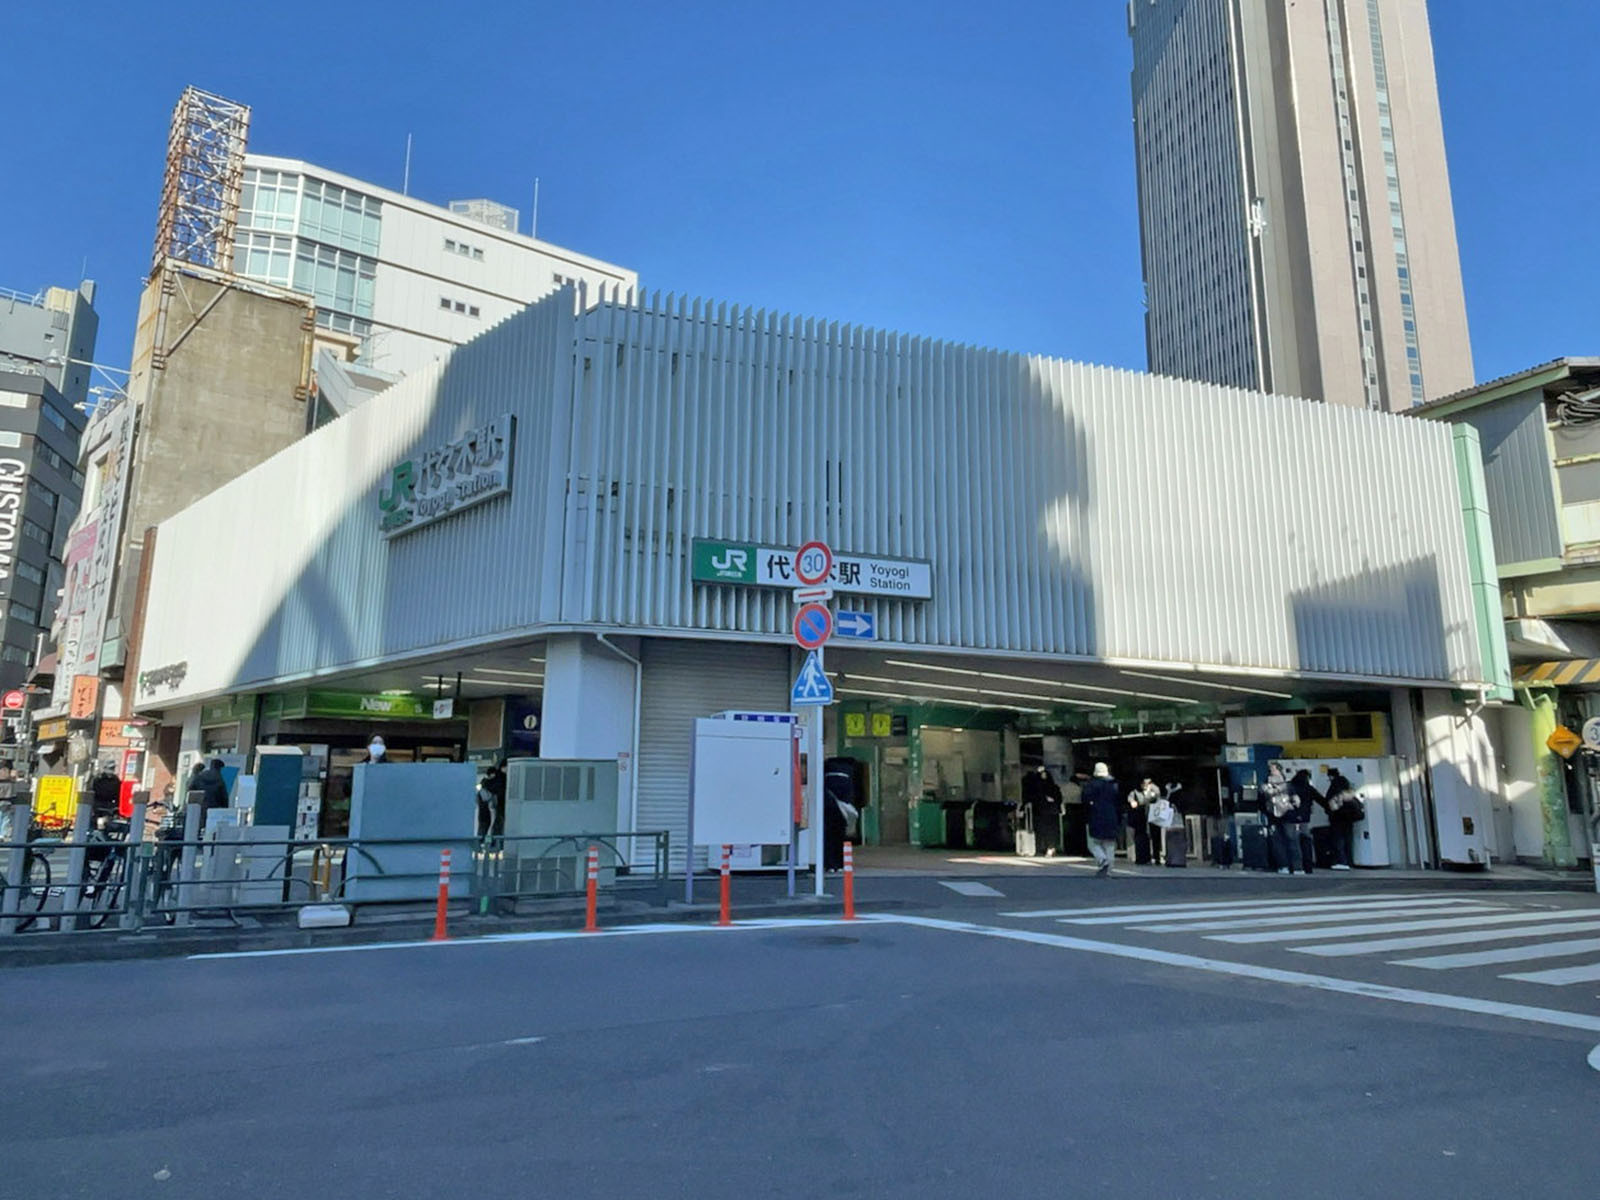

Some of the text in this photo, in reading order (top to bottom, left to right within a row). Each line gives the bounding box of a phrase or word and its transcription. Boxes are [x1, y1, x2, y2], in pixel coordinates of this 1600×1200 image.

[378, 460, 414, 512] JR
[711, 549, 861, 586] JR 代駅
[803, 553, 824, 573] 30
[870, 563, 909, 579] Yoyogi
[870, 577, 911, 590] Station
